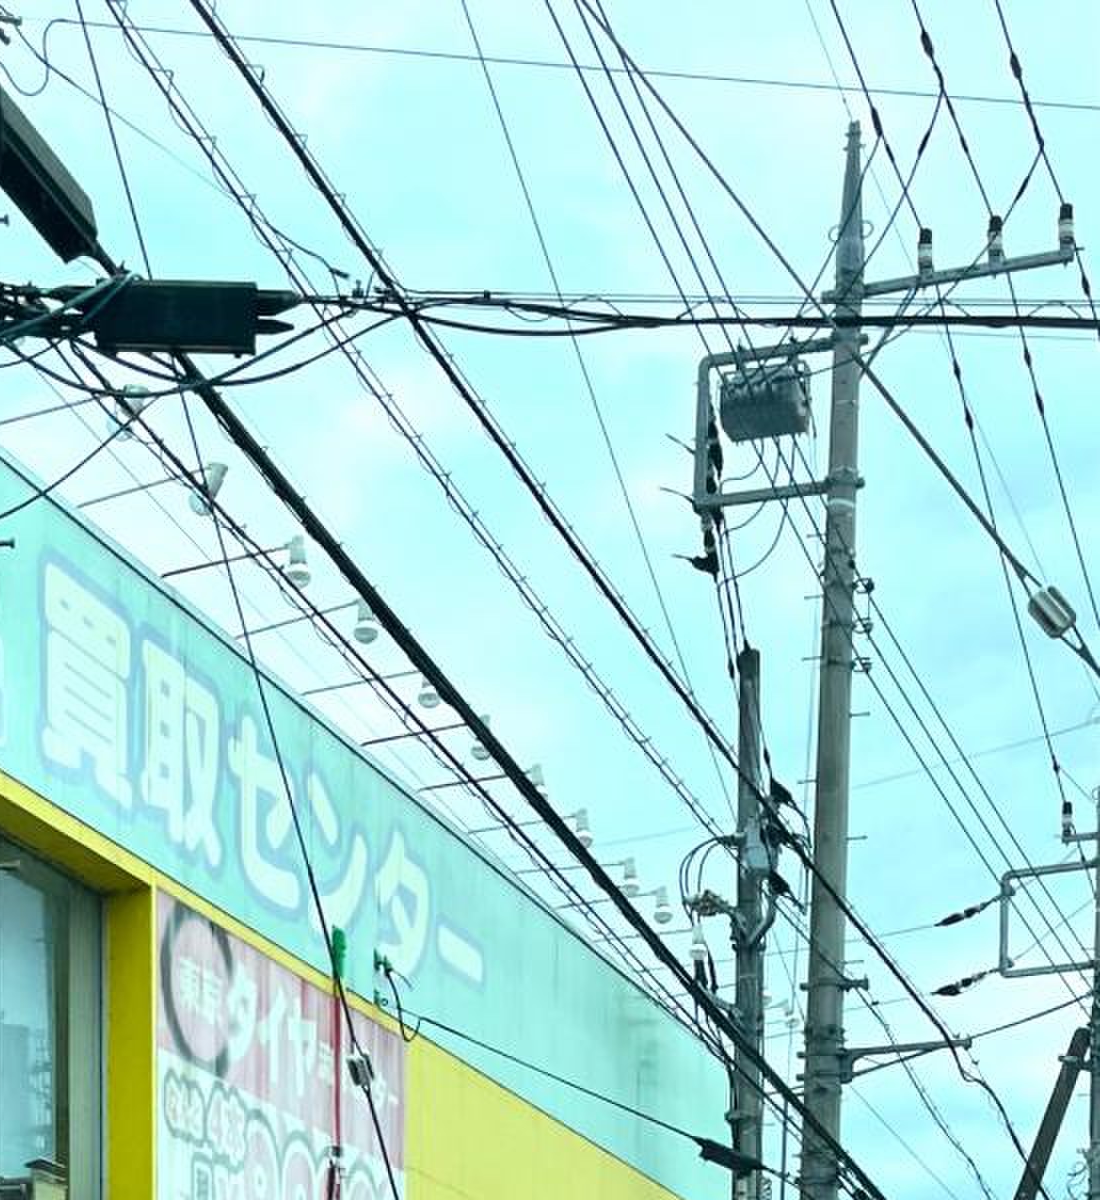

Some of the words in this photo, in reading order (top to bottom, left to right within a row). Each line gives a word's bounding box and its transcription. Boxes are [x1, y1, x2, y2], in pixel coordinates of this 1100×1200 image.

[40, 556, 484, 986] 買取センター
